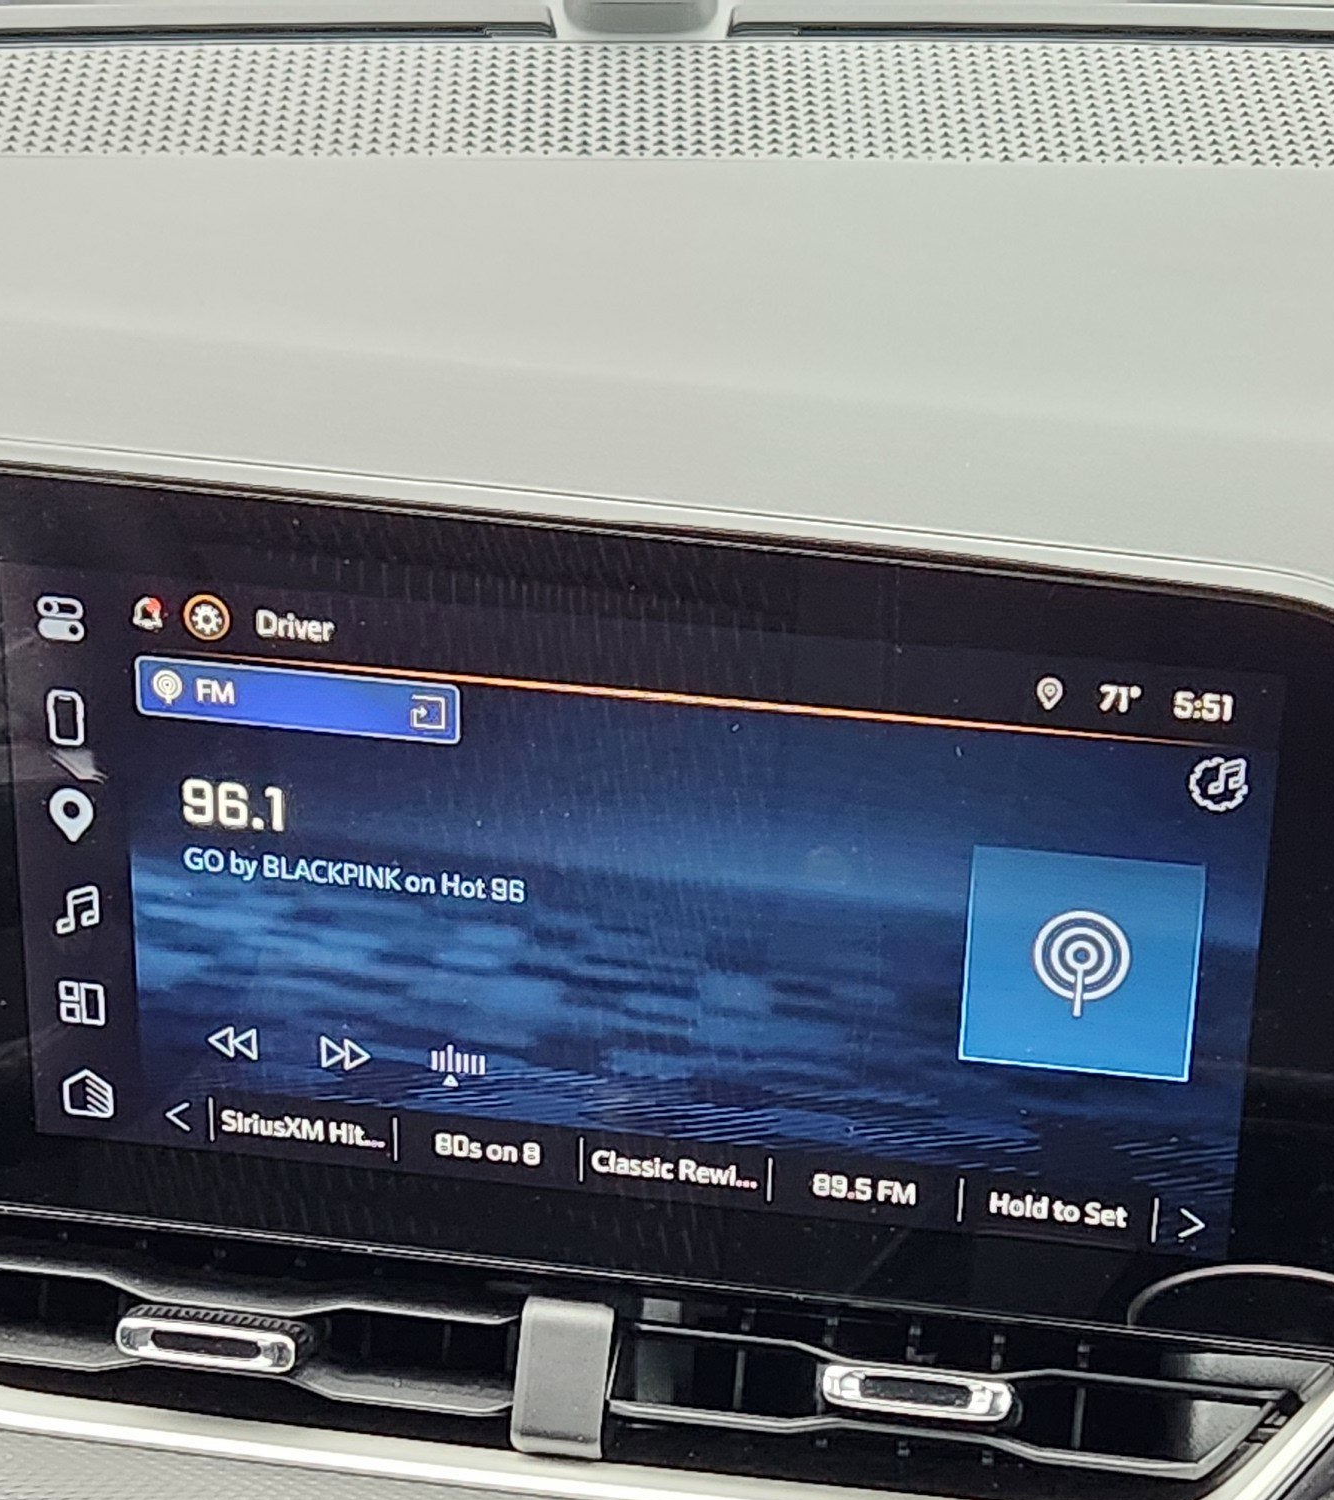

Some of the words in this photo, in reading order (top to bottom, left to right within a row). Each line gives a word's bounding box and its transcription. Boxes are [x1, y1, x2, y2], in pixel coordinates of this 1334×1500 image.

[255, 609, 335, 643] Driver
[195, 680, 235, 705] FM
[1099, 683, 1142, 713] 71°
[1173, 690, 1233, 722] 5:51
[182, 778, 285, 832] 96.1
[183, 847, 225, 873] GO
[229, 851, 258, 882] by
[262, 856, 402, 892] BLACKPINK
[405, 875, 437, 896] on
[440, 874, 487, 899] Hot
[490, 879, 526, 903] 96
[220, 1109, 325, 1141] SiriusXM
[434, 1132, 483, 1160] 80s
[486, 1144, 519, 1162] on
[522, 1142, 542, 1165] 8
[591, 1149, 675, 1181] Classic
[812, 1173, 873, 1201] 89.5
[877, 1180, 917, 1205] FM
[989, 1191, 1049, 1222] Hold
[1051, 1201, 1081, 1225] to
[1083, 1202, 1128, 1229] Set
